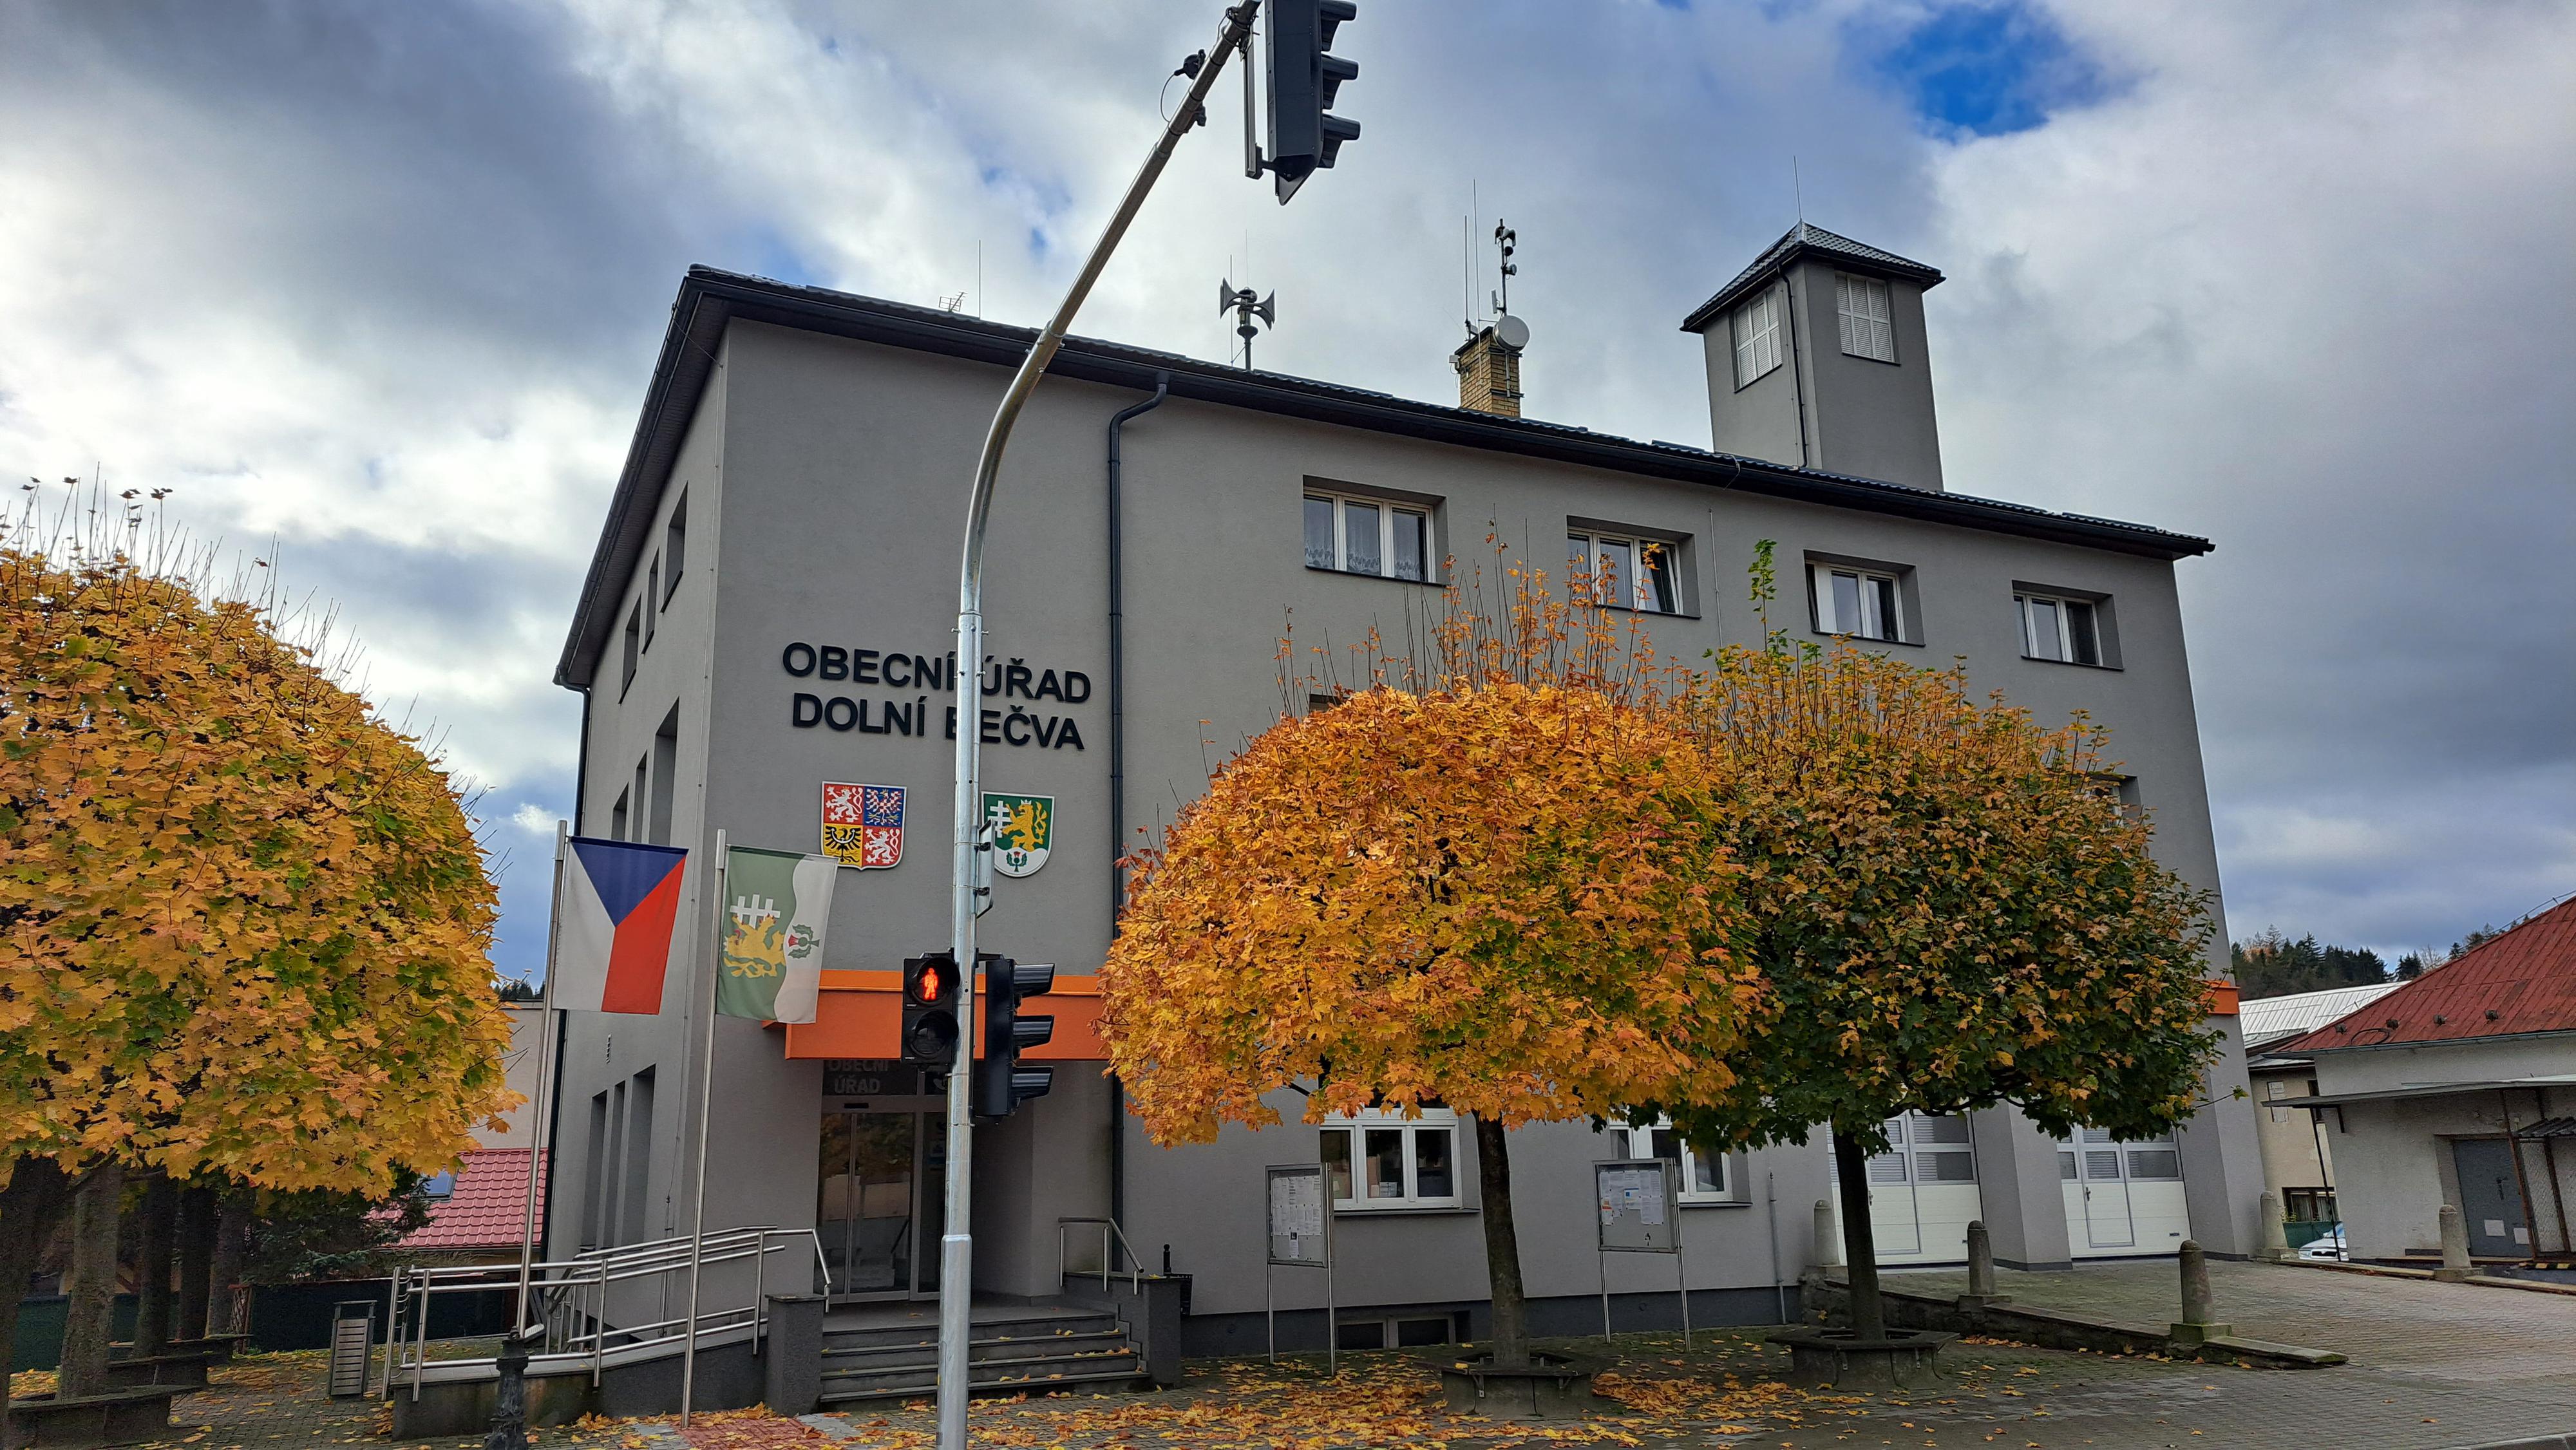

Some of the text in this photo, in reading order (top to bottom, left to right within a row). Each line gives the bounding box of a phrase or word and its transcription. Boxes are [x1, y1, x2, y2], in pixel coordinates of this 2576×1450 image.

[782, 642, 1091, 703] OBECNÍ ÚŘAD
[792, 692, 927, 737] DOLNÍ
